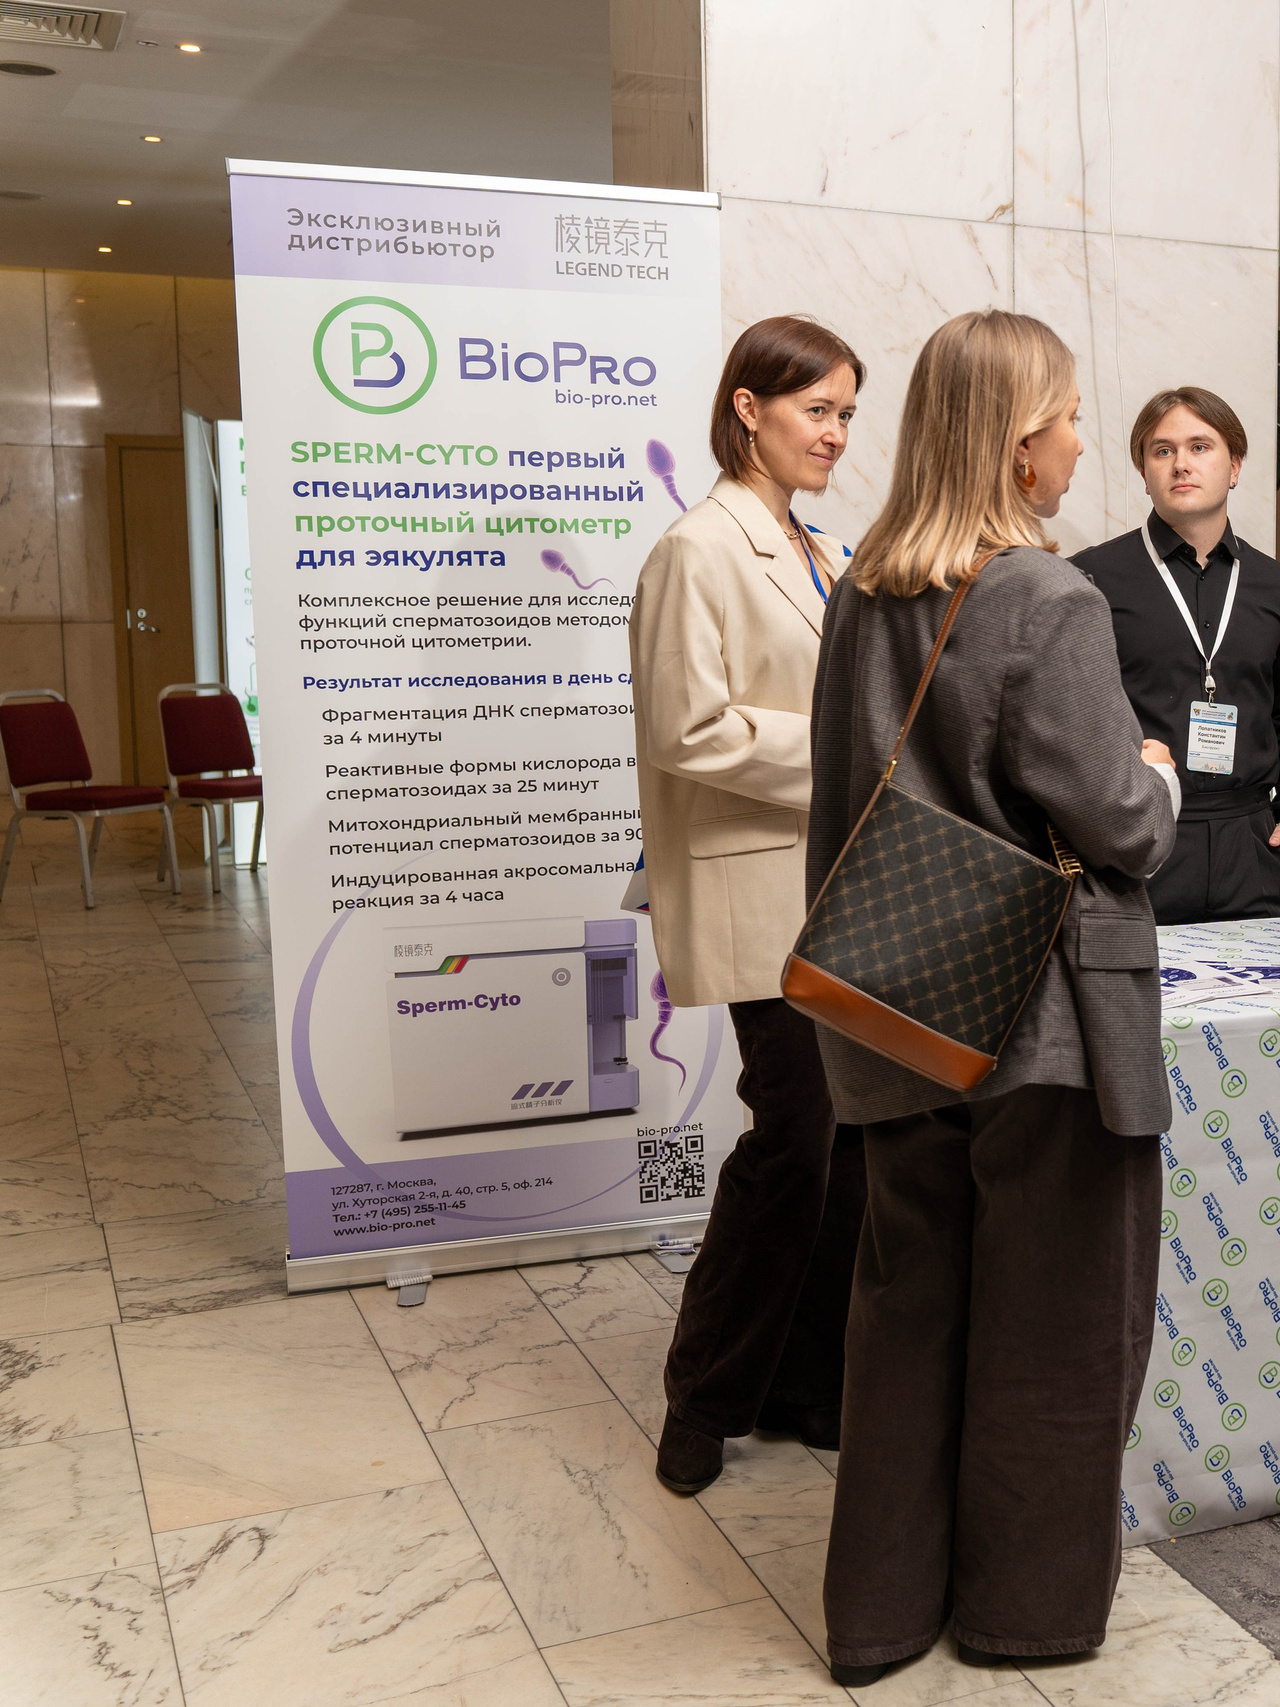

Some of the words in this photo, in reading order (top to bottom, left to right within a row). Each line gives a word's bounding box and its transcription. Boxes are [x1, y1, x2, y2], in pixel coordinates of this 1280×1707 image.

[286, 207, 501, 238] Эксклюзивный
[554, 213, 669, 259] 棱镜泰克
[287, 234, 495, 263] дистрибьютор
[555, 261, 623, 278] LEGEND
[626, 264, 669, 281] TECH
[555, 389, 658, 408] bio-pro.net
[290, 441, 499, 467] SPERM-CYTO
[508, 447, 626, 472] первый
[292, 480, 645, 505] специализированный
[295, 511, 475, 537] проточный
[485, 515, 633, 539] цитометр
[295, 549, 355, 570] для
[365, 550, 507, 572] эякулята
[298, 594, 431, 608] Комплексное
[436, 595, 523, 609] решение
[528, 595, 562, 608] для
[298, 614, 387, 632] функций
[392, 616, 551, 631] сперматозоидов
[300, 634, 406, 653] проточной
[411, 636, 532, 650] цитометрии.
[303, 676, 402, 692] Результат
[408, 674, 547, 688] исследования
[552, 674, 563, 685] в
[568, 673, 613, 686] день
[322, 708, 468, 725] Фрагментация
[473, 705, 515, 721] ДНК
[323, 734, 344, 745] за
[349, 731, 362, 744] 4
[368, 731, 442, 745] минуты
[325, 763, 444, 778] Реактивные
[449, 760, 517, 776] формы
[522, 757, 621, 772] кислорода
[626, 757, 637, 767] в
[326, 784, 487, 802] сперматозоидах
[492, 783, 512, 794] за
[517, 779, 538, 793] 25
[543, 779, 600, 794] минут
[328, 811, 522, 833] Митохондриальный
[329, 840, 434, 855] потенциал
[439, 832, 596, 851] сперматозоидов
[601, 831, 620, 843] за
[331, 868, 498, 889] Индуцированная
[504, 861, 636, 880] акросомальна
[332, 895, 414, 913] реакция
[419, 894, 440, 905] за
[445, 890, 458, 903] 4
[462, 890, 504, 902] часа
[396, 993, 522, 1017] Sperm-Cyto
[636, 1122, 704, 1138] bio-pro.net
[330, 1183, 374, 1196] 127287,
[376, 1183, 385, 1192] г.
[387, 1178, 437, 1190] Москва,
[331, 1201, 350, 1211] ул.
[352, 1192, 416, 1209] Хуторская
[418, 1190, 440, 1200] 2-я,
[441, 1190, 453, 1199] д.
[455, 1186, 474, 1197] 40,
[475, 1184, 499, 1195] стр.
[500, 1181, 511, 1192] 5,
[513, 1179, 533, 1191] оф.
[534, 1176, 554, 1187] 214
[332, 1212, 361, 1223] Тел.:
[363, 1209, 378, 1219] +7
[381, 1205, 411, 1219] (495)
[413, 1200, 467, 1214] 255-11-45
[333, 1217, 437, 1237] www.bio-pro.net
